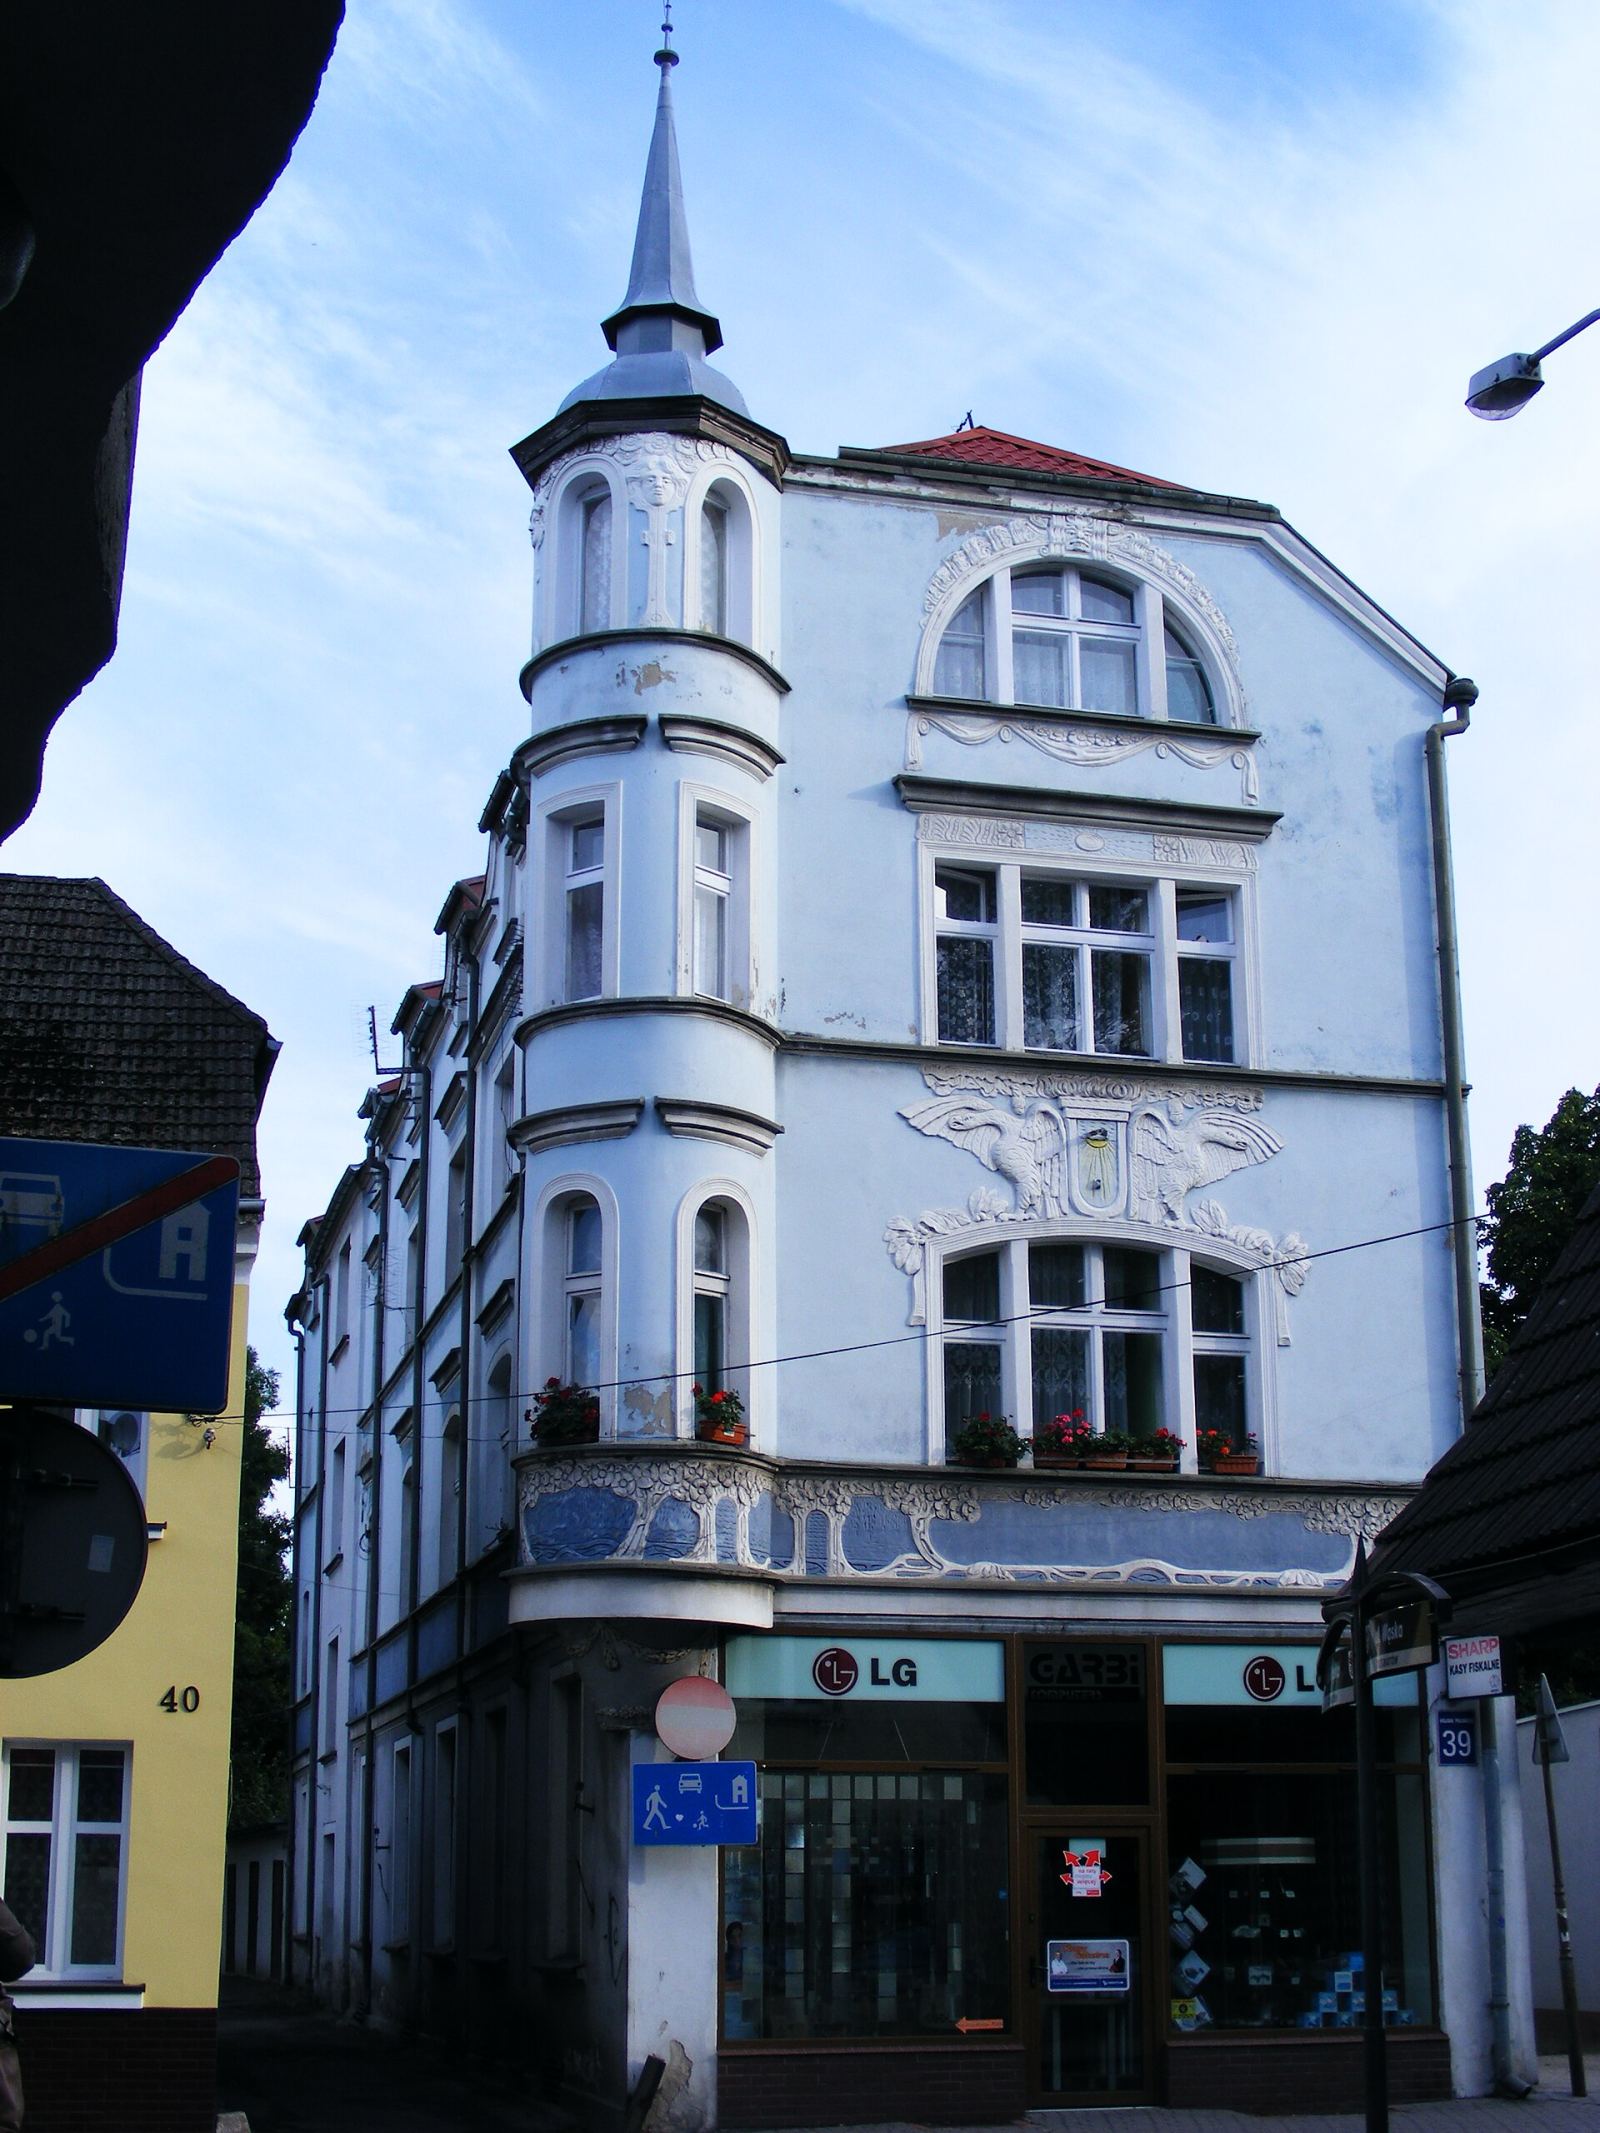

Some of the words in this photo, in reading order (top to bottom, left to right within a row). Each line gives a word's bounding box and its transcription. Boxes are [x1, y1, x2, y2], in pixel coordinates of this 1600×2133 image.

[1448, 1638, 1498, 1659] SHARP
[871, 1658, 917, 1687] LG
[1296, 1665, 1315, 1692] L
[1449, 1663, 1467, 1676] KASY
[1468, 1659, 1500, 1673] FISKALNE
[158, 1685, 200, 1713] 40
[1442, 1730, 1471, 1757] 39
